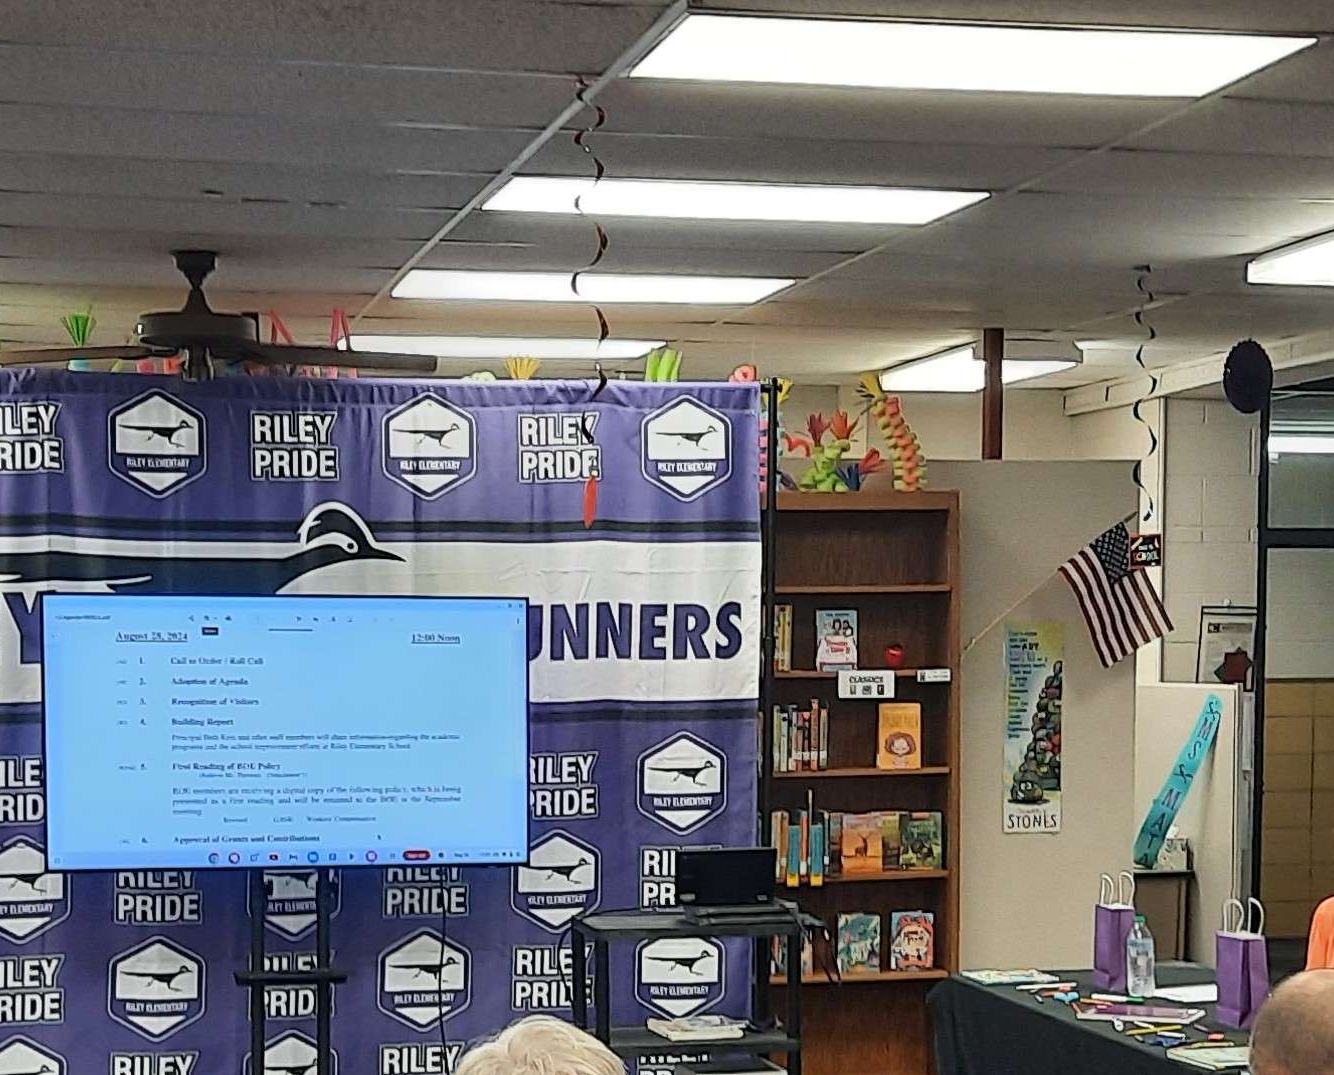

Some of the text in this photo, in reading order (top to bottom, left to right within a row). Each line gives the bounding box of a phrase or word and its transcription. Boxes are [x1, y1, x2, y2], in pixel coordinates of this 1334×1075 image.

[254, 415, 332, 444] RILEY
[521, 416, 597, 446] RILEY
[254, 450, 336, 478] PRIDE
[399, 460, 461, 471] RILEY ELEMENTARY
[115, 631, 148, 641] August
[437, 633, 460, 642] Noon
[170, 656, 187, 665] Call
[247, 656, 264, 665] Call
[171, 677, 207, 687] Adoption
[219, 677, 248, 687] Agenda
[171, 697, 217, 707] Recognition
[171, 717, 205, 727] Building
[206, 717, 234, 728] Report
[193, 762, 225, 772] Reading
[172, 836, 210, 845] Approval
[267, 834, 320, 842] Contributions
[284, 900, 317, 912] ELEMENTA
[386, 887, 466, 916] PRIDE
[118, 894, 199, 922] PRIDE
[264, 989, 317, 1018] RID
[413, 993, 455, 1003] ELEMENARY
[383, 1046, 462, 1075] RILEY
